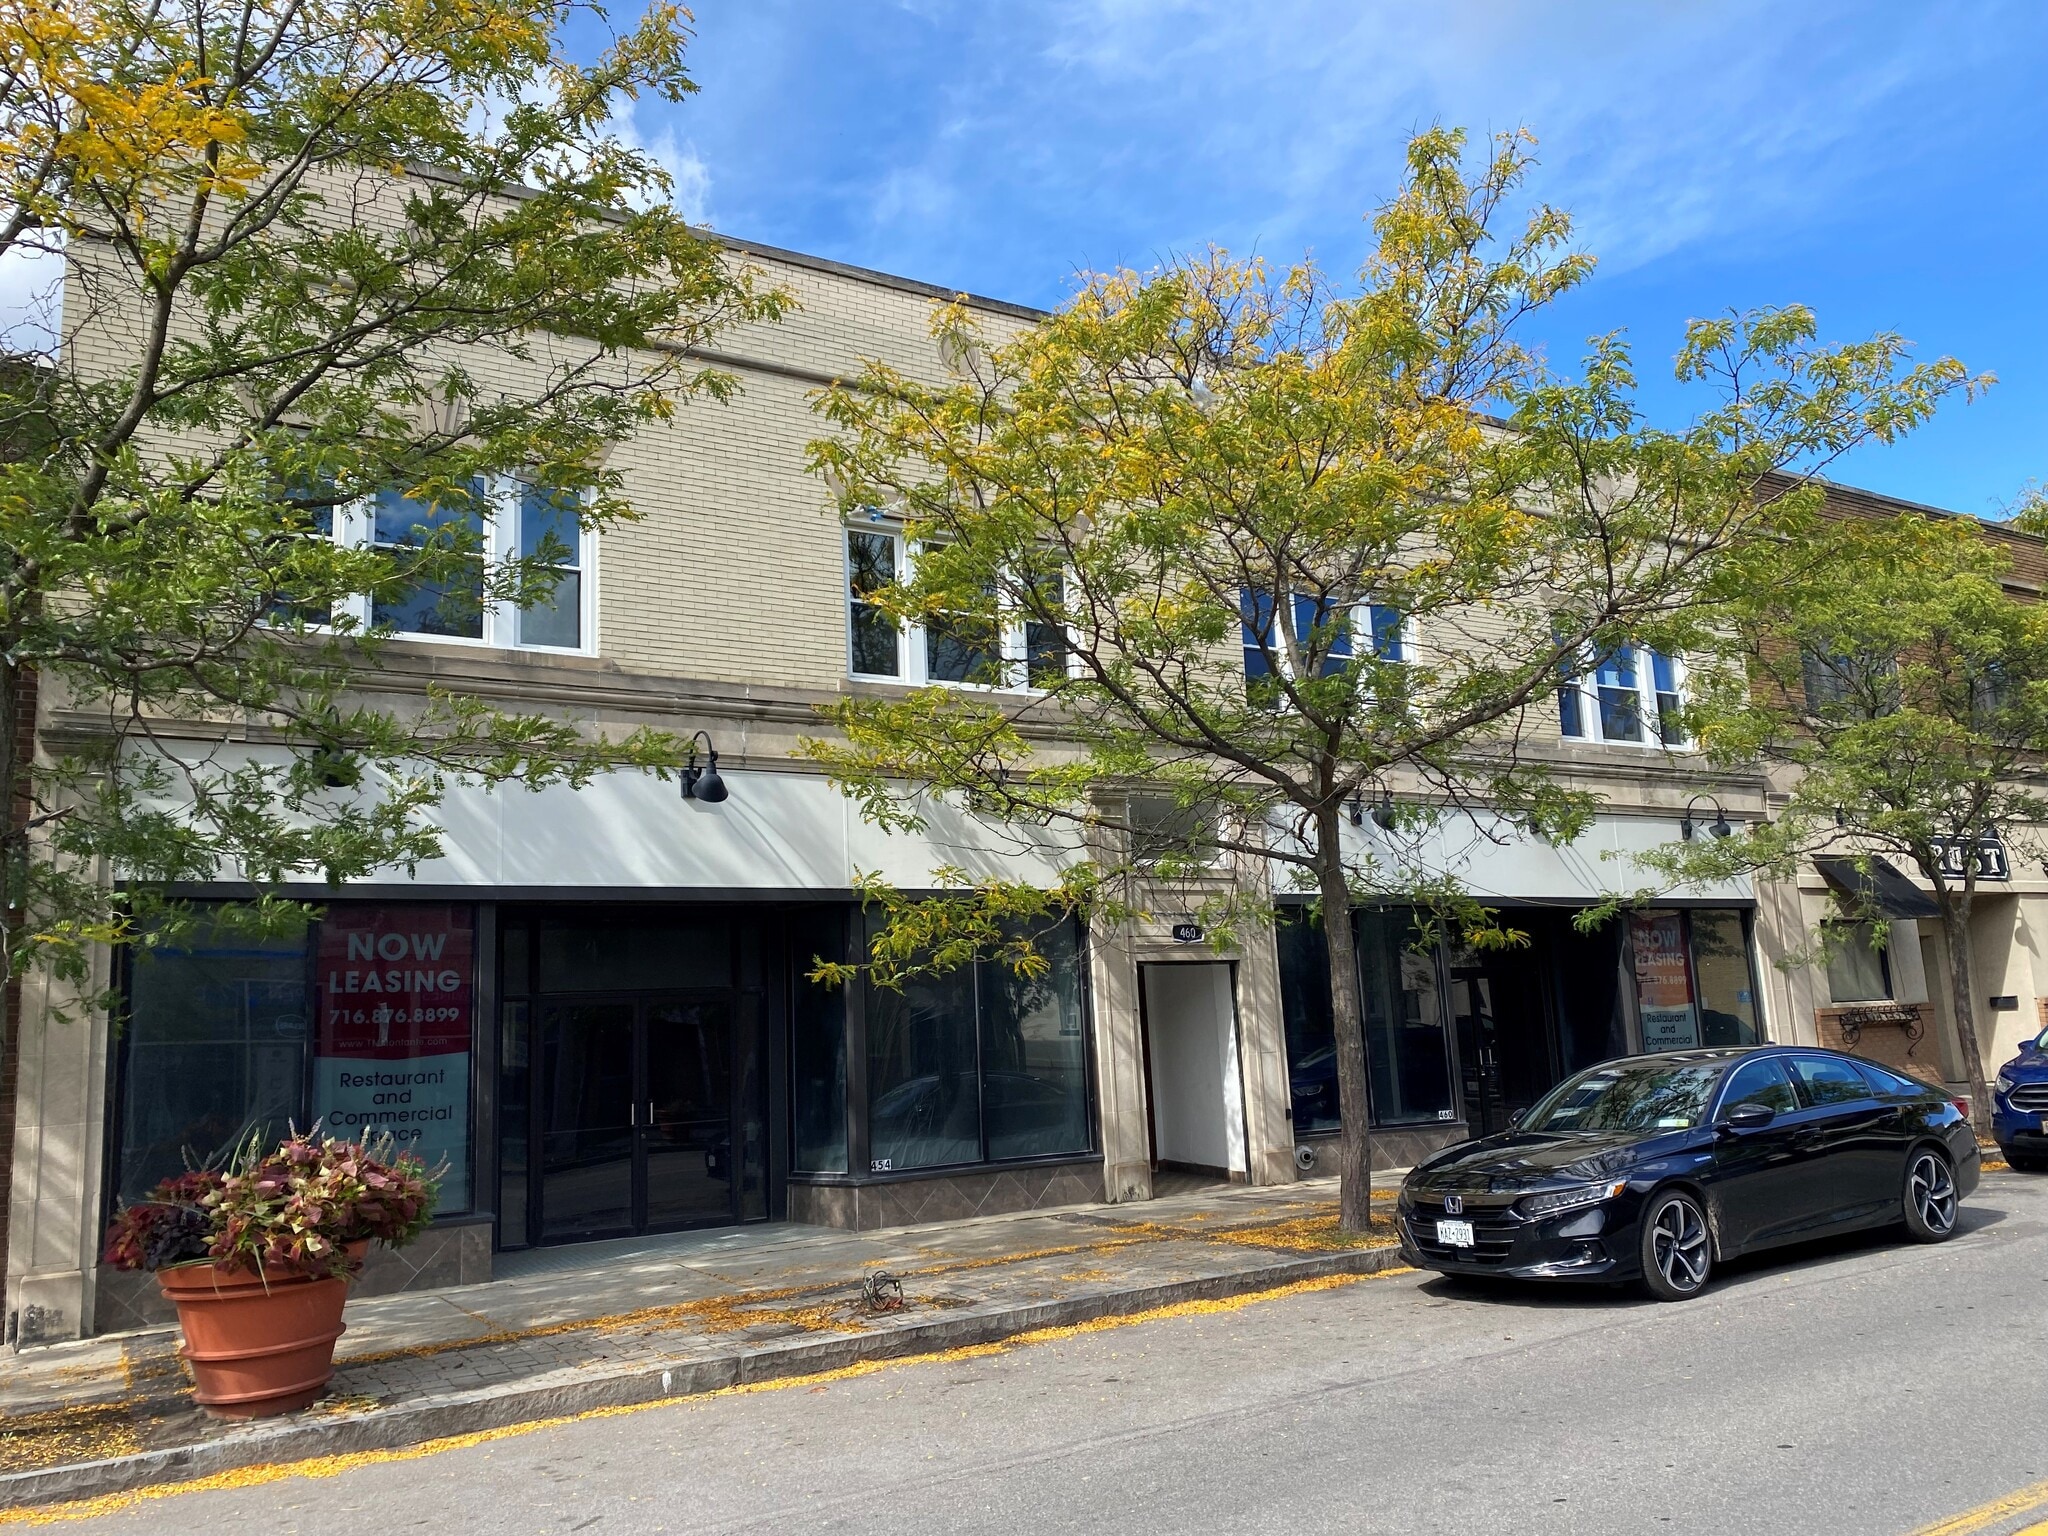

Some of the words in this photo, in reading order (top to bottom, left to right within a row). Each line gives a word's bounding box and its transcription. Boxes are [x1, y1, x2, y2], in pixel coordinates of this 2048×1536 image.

[1180, 927, 1196, 938] 460
[1637, 929, 1676, 948] NOW
[347, 933, 446, 961] NOW
[329, 970, 461, 993] LEASING
[1647, 1013, 1687, 1023] Restaurant
[1660, 1024, 1676, 1033] and
[1646, 1035, 1693, 1046] Commercial
[340, 1070, 444, 1087] Restaurant
[372, 1090, 412, 1104] and
[329, 1105, 453, 1126] Commercial
[1439, 1110, 1453, 1118] 460
[870, 1160, 890, 1170] 454
